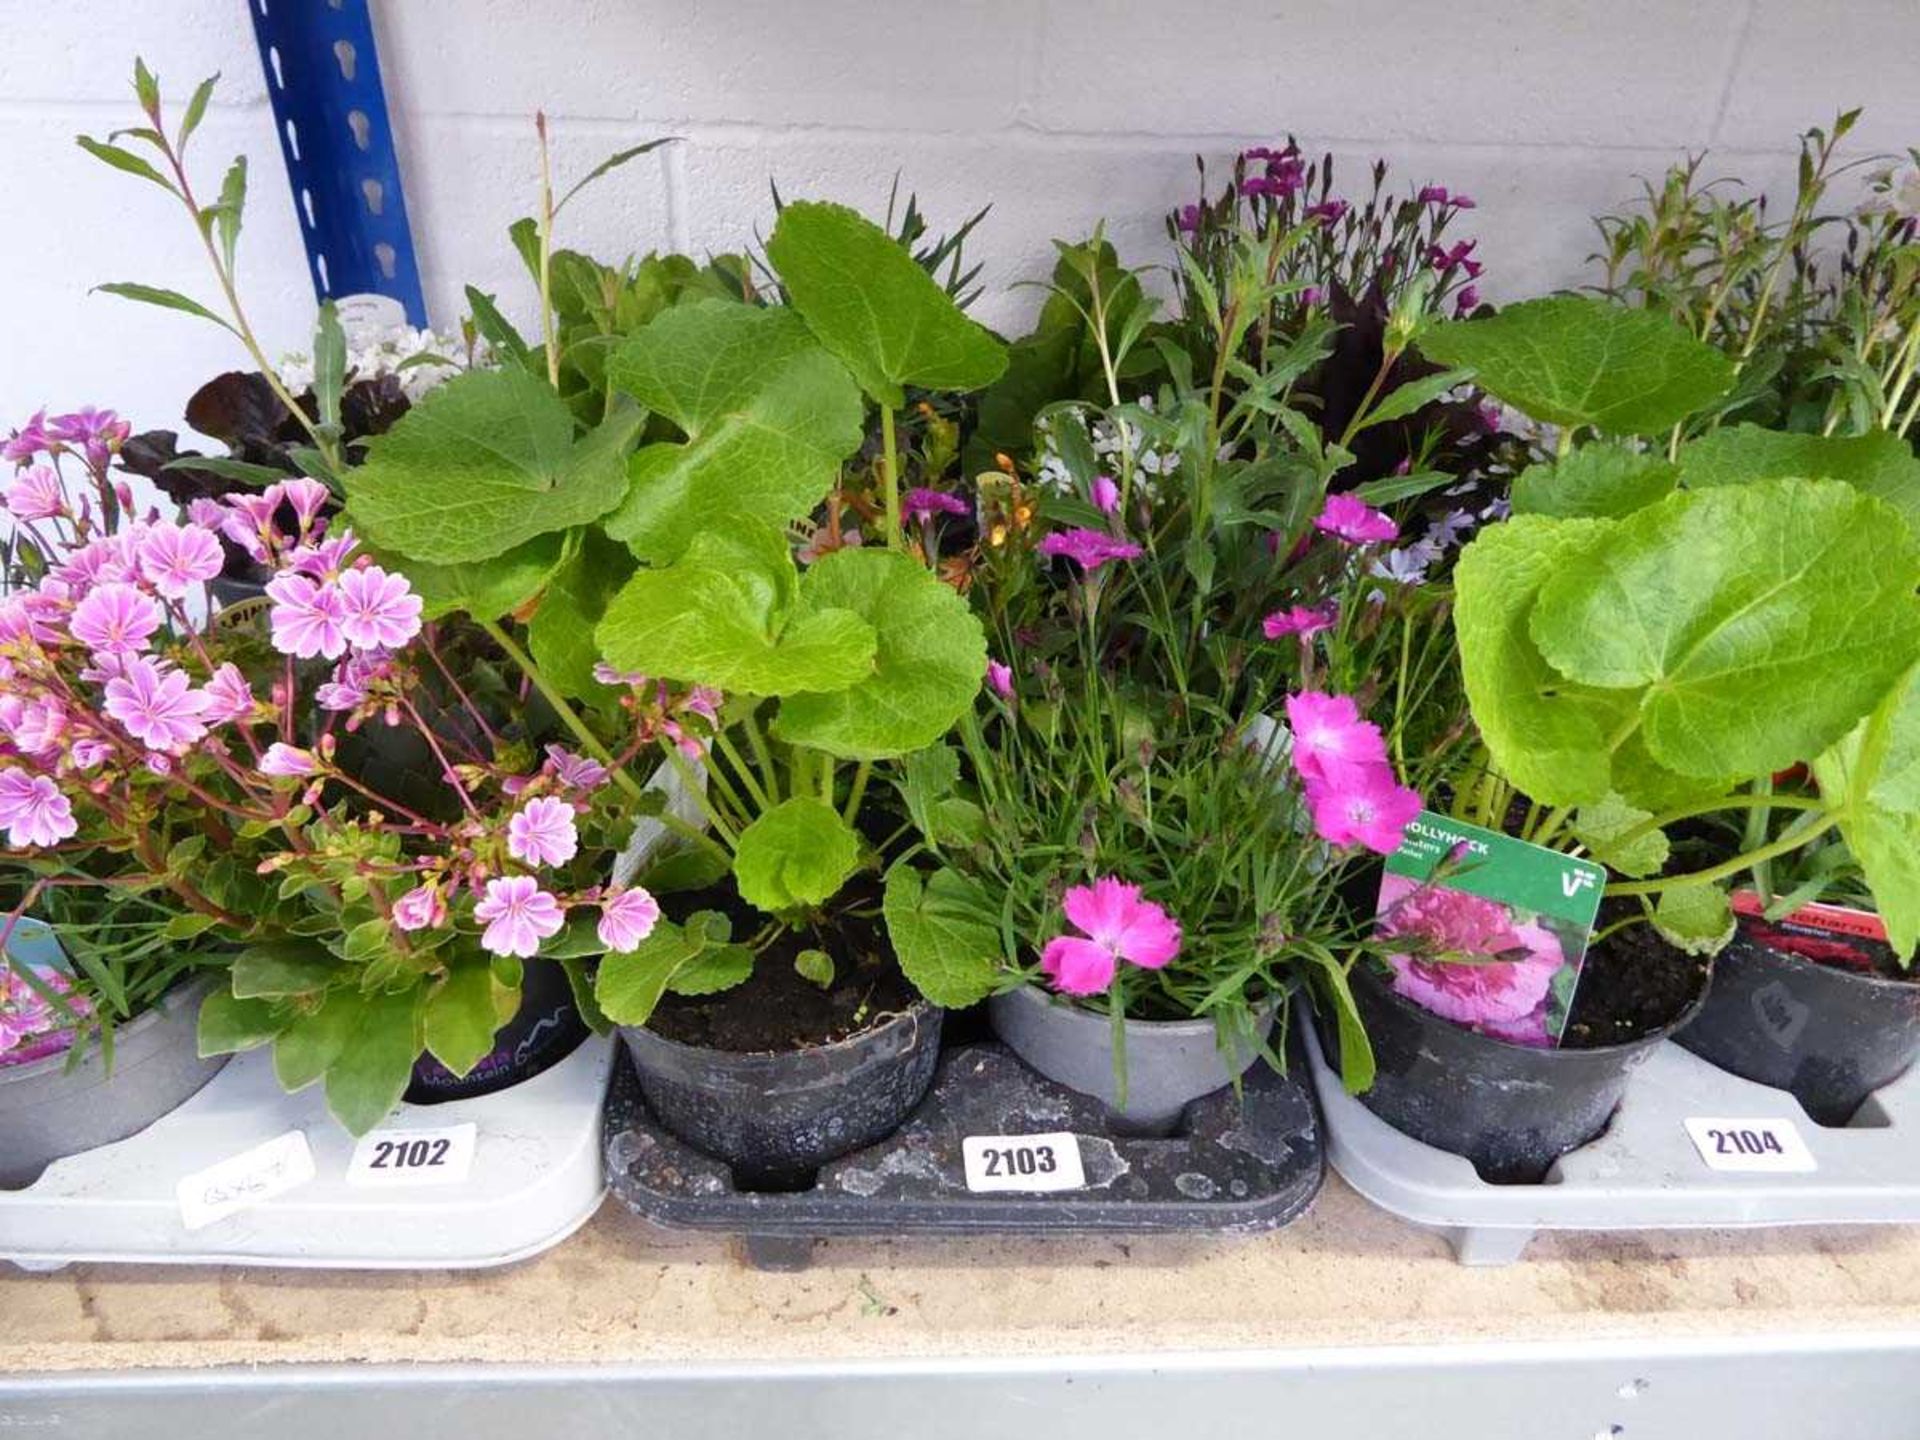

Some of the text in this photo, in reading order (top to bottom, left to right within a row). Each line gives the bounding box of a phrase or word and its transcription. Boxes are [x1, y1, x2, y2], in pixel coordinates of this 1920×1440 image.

[1405, 821, 1489, 855] OLLYHCK
[369, 1138, 451, 1169] 2102
[1707, 1129, 1784, 1155] 2104
[982, 1145, 1057, 1177] 2103
